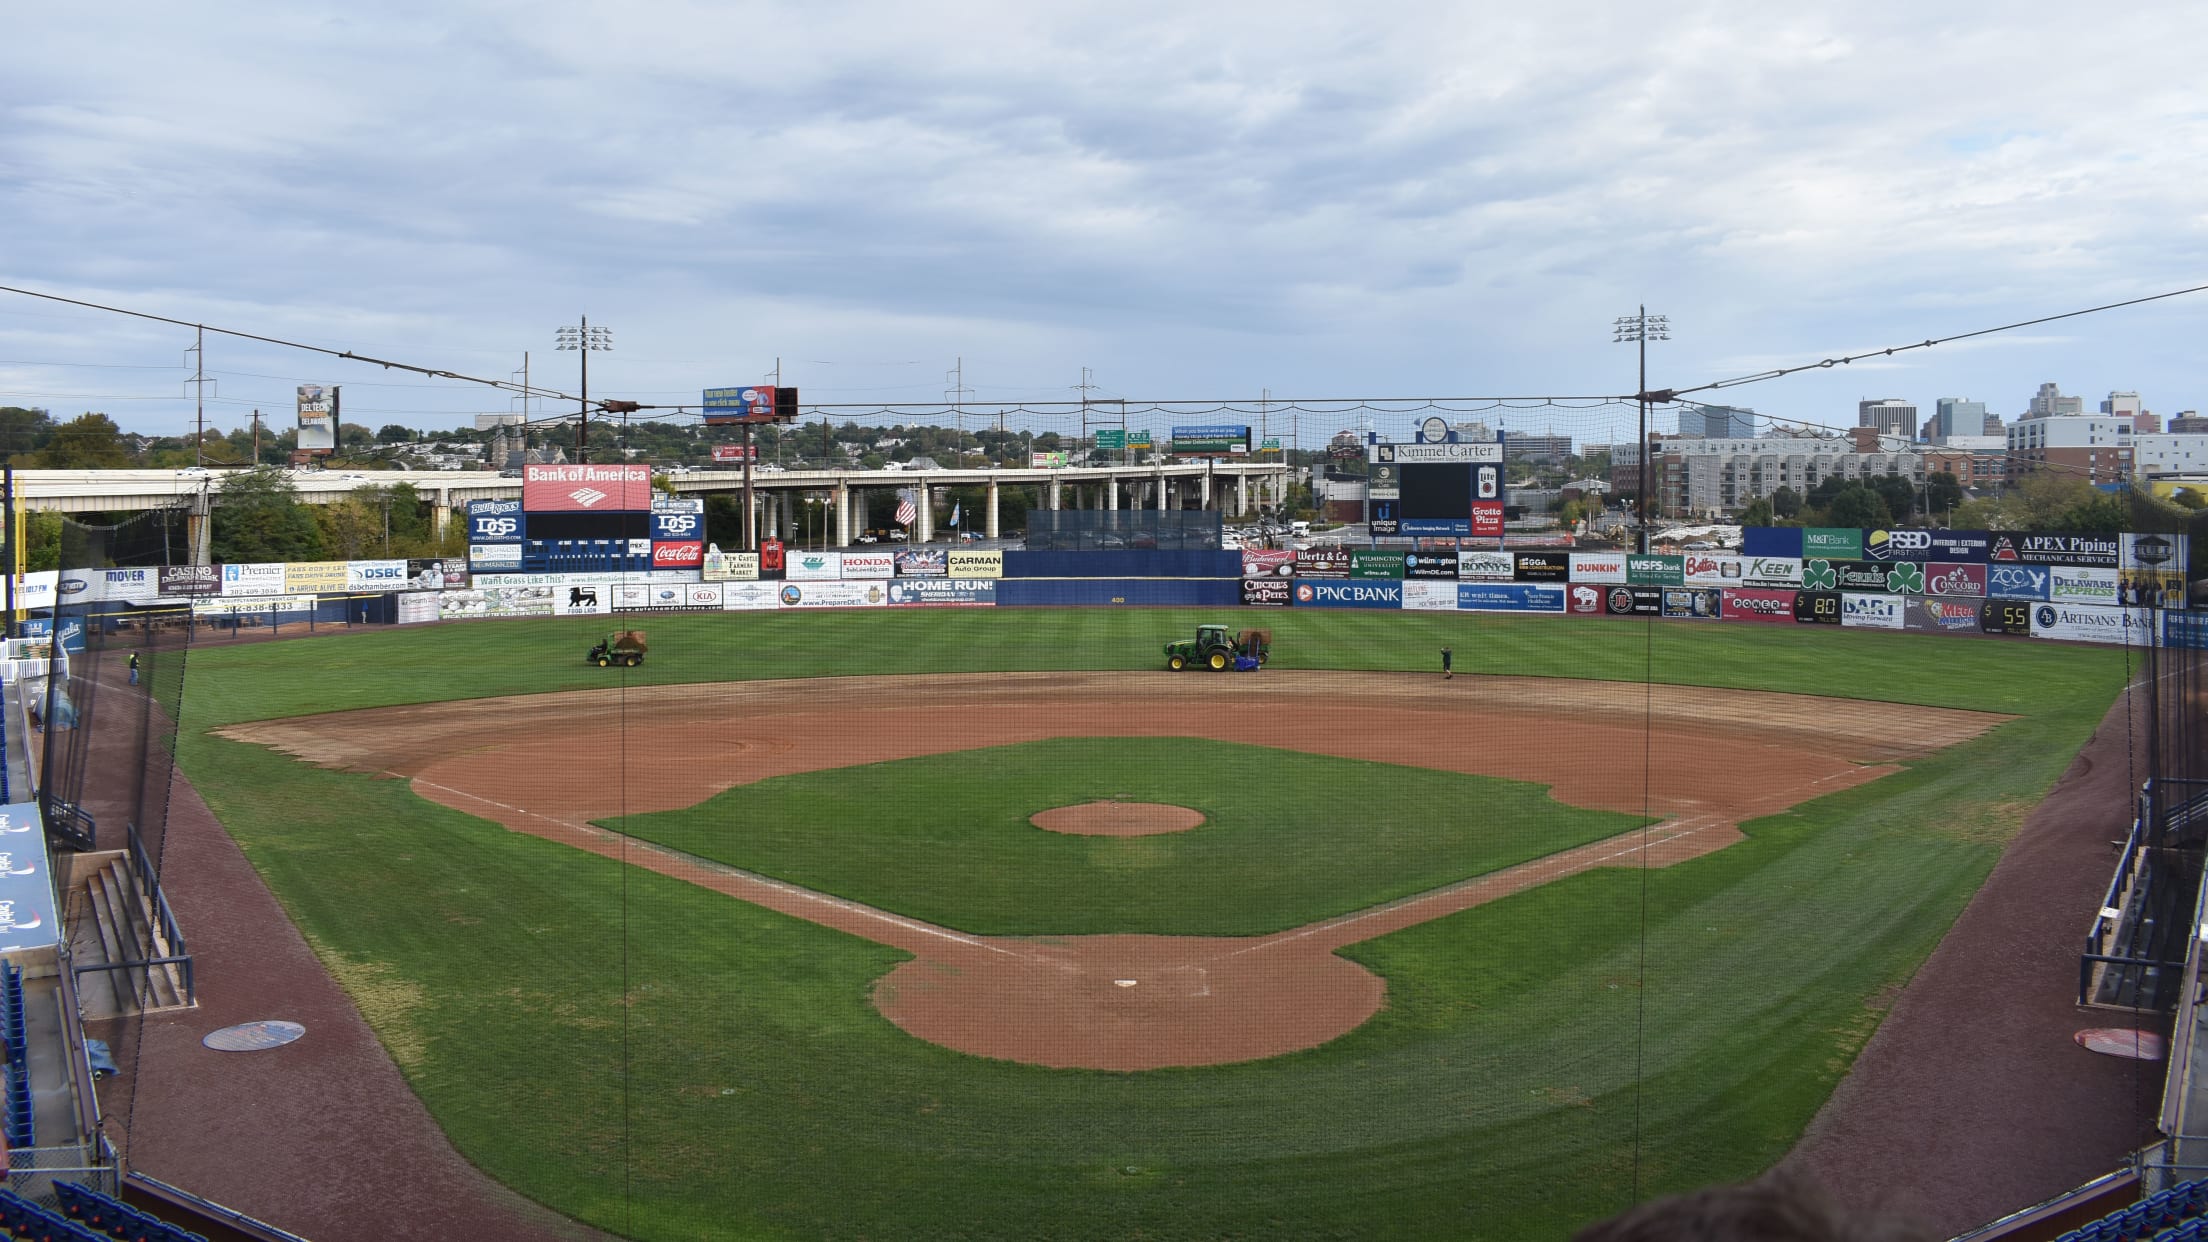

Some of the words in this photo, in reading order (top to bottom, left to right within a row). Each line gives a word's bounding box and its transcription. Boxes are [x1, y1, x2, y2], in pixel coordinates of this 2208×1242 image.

[1398, 445, 1446, 457] Kimmel
[1449, 445, 1494, 457] Carter
[528, 468, 566, 482] Bank
[568, 468, 584, 481] of
[586, 468, 647, 482] America
[1480, 472, 1495, 483] Lite
[471, 502, 494, 514] BLUE
[491, 501, 519, 515] ROCKS
[1472, 507, 1502, 516] Grotto
[1475, 515, 1498, 524] Pizza
[1807, 534, 1828, 544] M&T
[1828, 535, 1850, 545] Bank
[1888, 531, 1932, 549] FSBD
[2021, 537, 2066, 551] APEX
[2070, 537, 2117, 556] Piping
[843, 558, 892, 566] HONDA
[950, 557, 1001, 565] CARMAN
[1243, 554, 1288, 563] Budweiser
[1297, 552, 1325, 561] Wertz
[1326, 552, 1334, 561] &
[1419, 556, 1457, 566] wilmington
[2022, 554, 2076, 563] MECHANICAL
[2077, 556, 2117, 564] SERVICES
[241, 564, 282, 575] Premier
[1461, 562, 1511, 572] RONNY'S
[1576, 563, 1621, 573] DUNKIN'
[1630, 560, 1663, 571] WSFS
[1663, 563, 1681, 571] bank
[1686, 557, 1720, 577] Botto's
[1750, 559, 1794, 576] KEEN
[168, 566, 212, 577] CASINO
[364, 567, 403, 579] DSBC
[480, 576, 501, 585] Want
[503, 576, 525, 585] Grass
[527, 575, 543, 584] Like
[545, 574, 565, 583] This?
[1991, 568, 2025, 587] ZOO
[2053, 576, 2115, 589] DELAWARE
[25, 584, 38, 593] 101.7
[38, 584, 48, 592] FM
[297, 584, 318, 592] ARRIVE
[320, 583, 336, 591] ALIVE
[348, 582, 406, 591] dsbchamber.com
[903, 580, 952, 591] HOME
[955, 580, 993, 590] RUN!
[1244, 580, 1289, 591] CHICKIE'S
[1930, 575, 1981, 594] CONCORD
[1262, 590, 1289, 601] PETE'S
[1315, 587, 1352, 601] PNC
[1354, 587, 1400, 602] BANK
[2053, 586, 2116, 597] EXPRESS
[583, 606, 597, 614] LION
[1815, 598, 1836, 615] 80
[1844, 598, 1902, 616] DART
[1940, 603, 1975, 618] MEGA
[1985, 605, 1992, 616] $
[1866, 614, 1893, 622] Forward
[2004, 607, 2025, 625] 55
[2059, 610, 2119, 627] ARTISANS'
